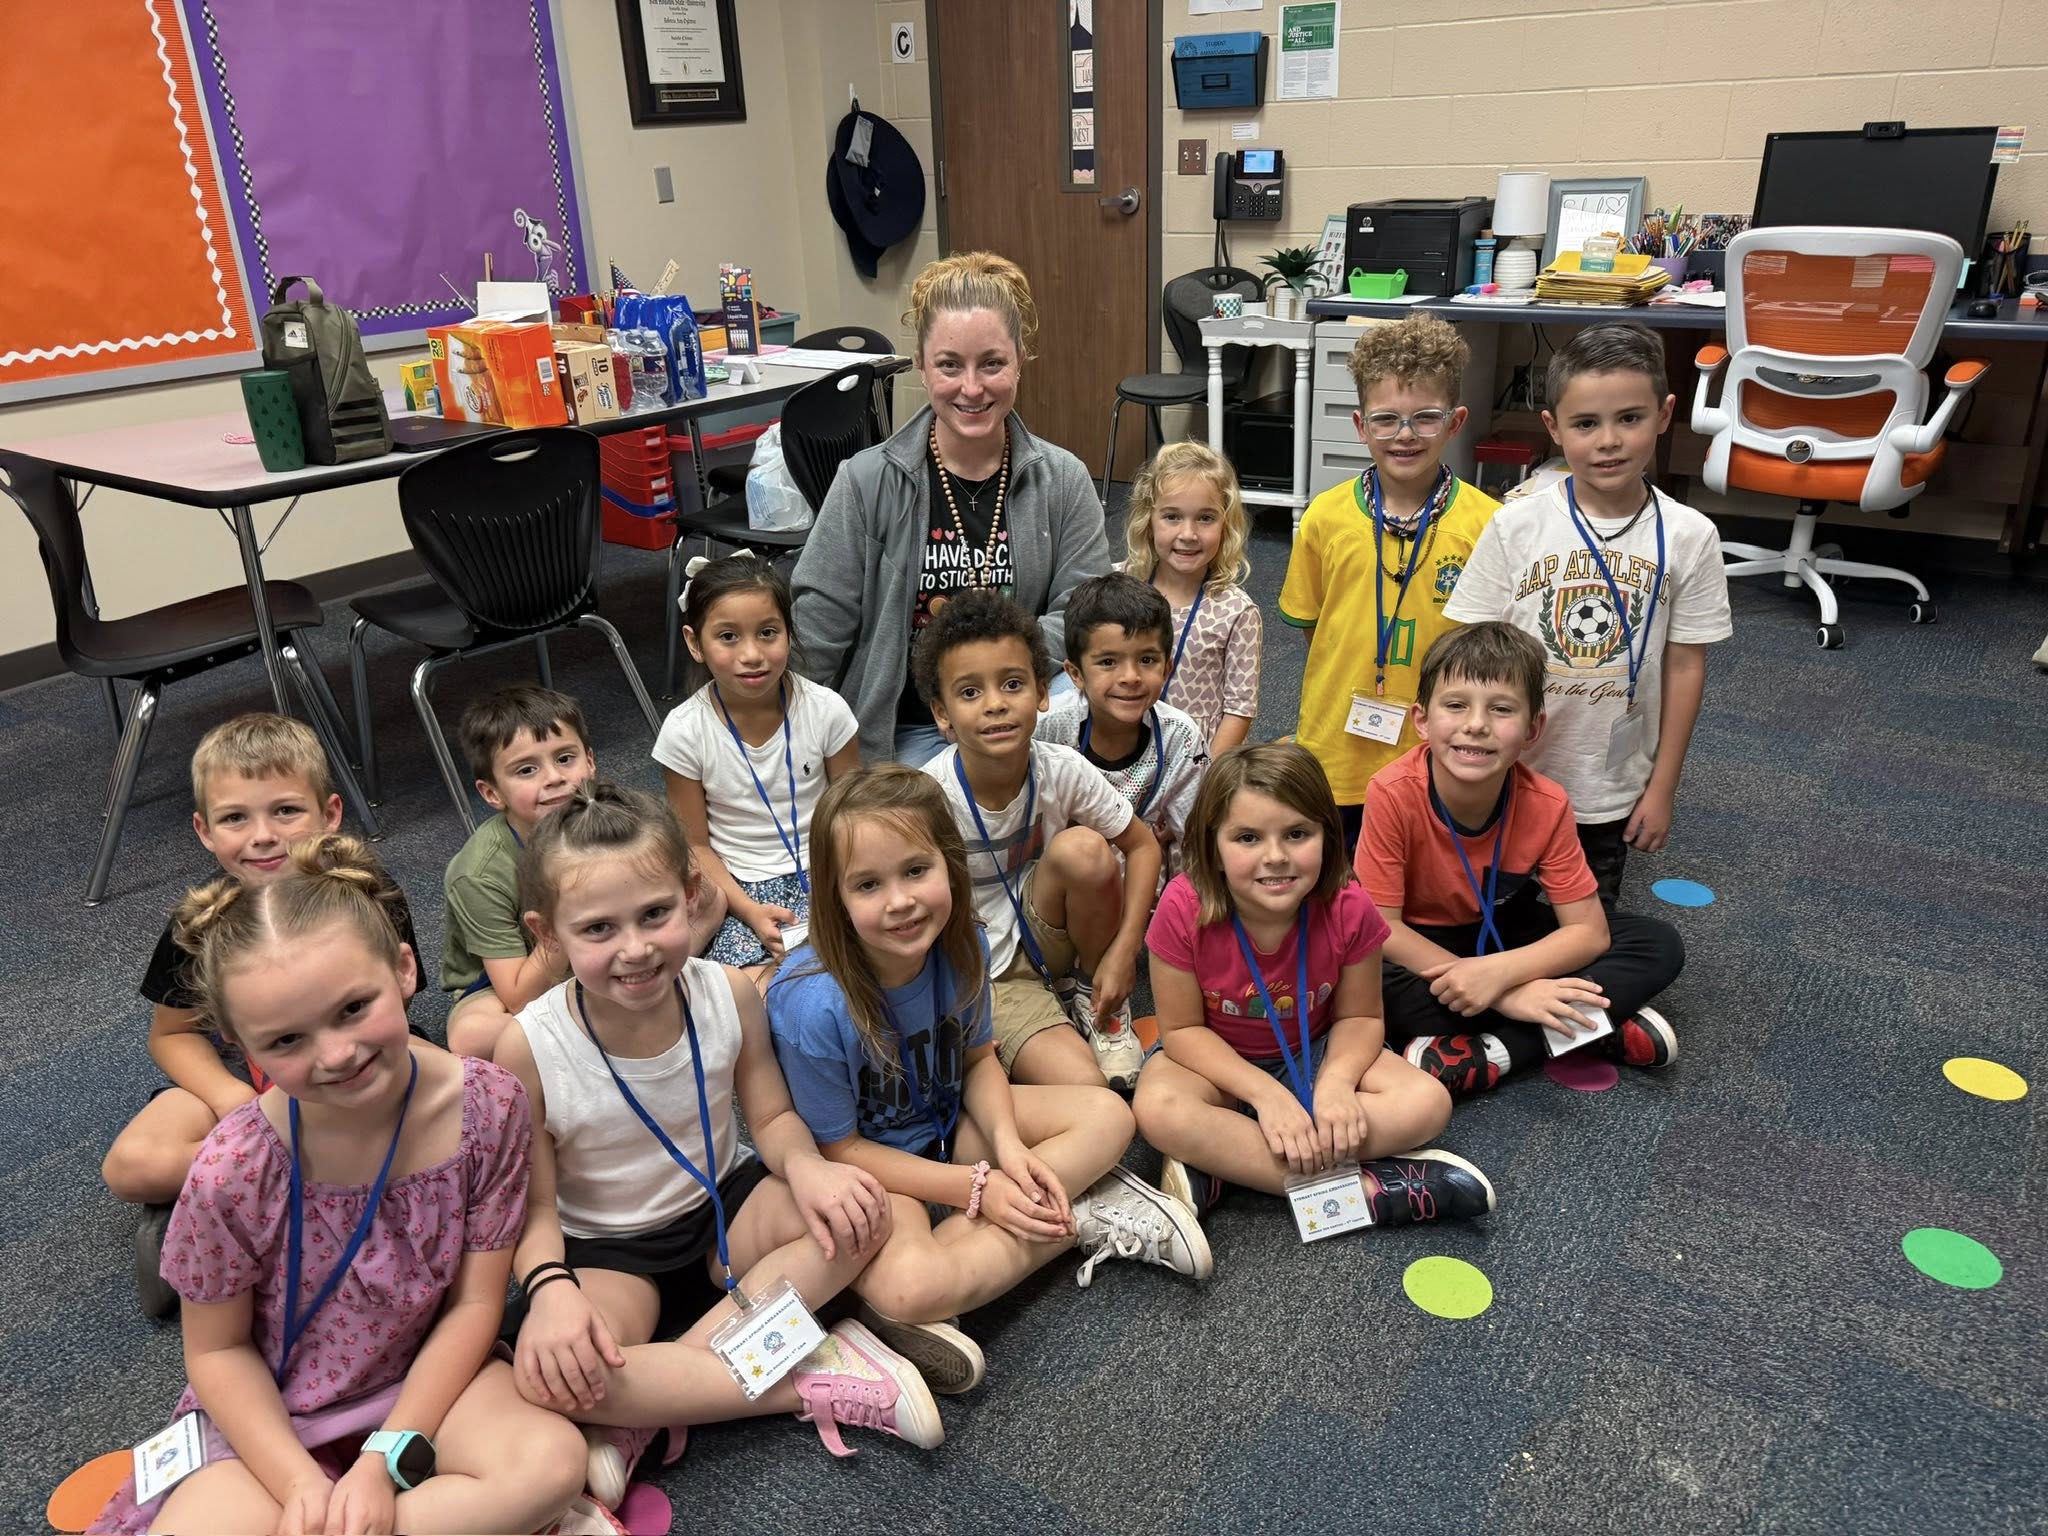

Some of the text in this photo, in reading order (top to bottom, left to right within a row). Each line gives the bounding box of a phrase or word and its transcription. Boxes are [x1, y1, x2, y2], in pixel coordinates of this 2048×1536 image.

[897, 31, 910, 56] C
[430, 340, 439, 358] 20
[598, 358, 609, 373] 10
[925, 544, 971, 569] HAVE
[920, 573, 936, 591] TO
[1563, 549, 1671, 606] ATHLETC
[1565, 681, 1588, 696] the
[1588, 681, 1629, 705] Goal
[1245, 980, 1292, 997] hllo
